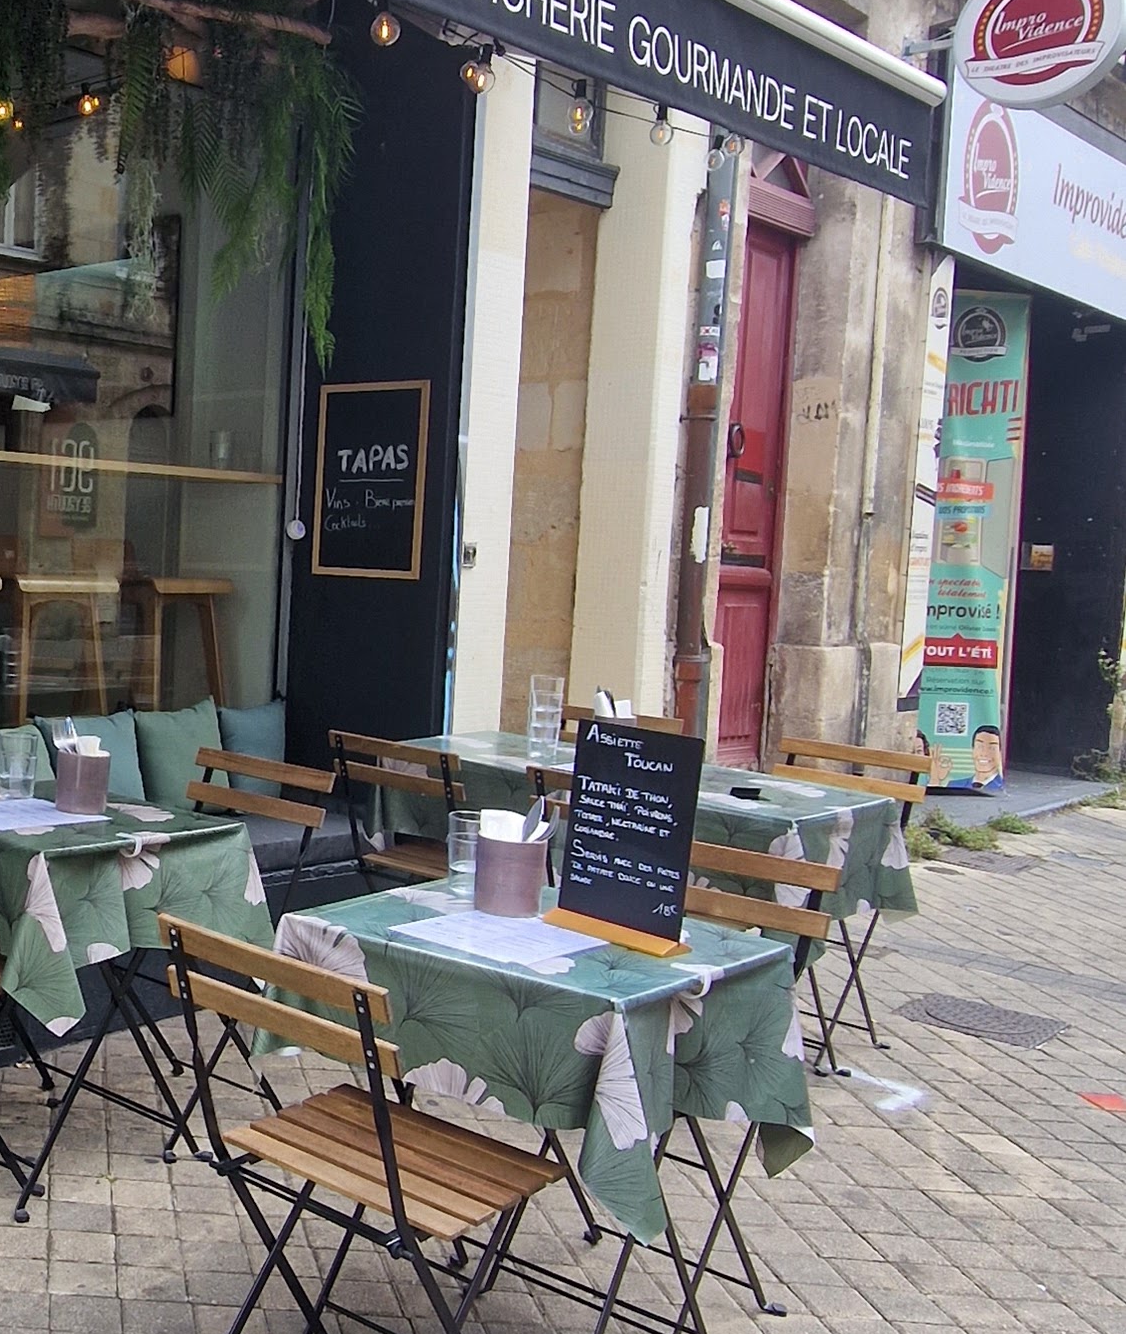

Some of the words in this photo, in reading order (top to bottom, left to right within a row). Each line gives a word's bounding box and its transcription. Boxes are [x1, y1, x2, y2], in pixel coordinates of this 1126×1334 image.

[629, 15, 797, 130] GOURMANDE
[802, 94, 833, 142] ET
[836, 109, 912, 179] LOCALE
[337, 444, 409, 474] TAPAS
